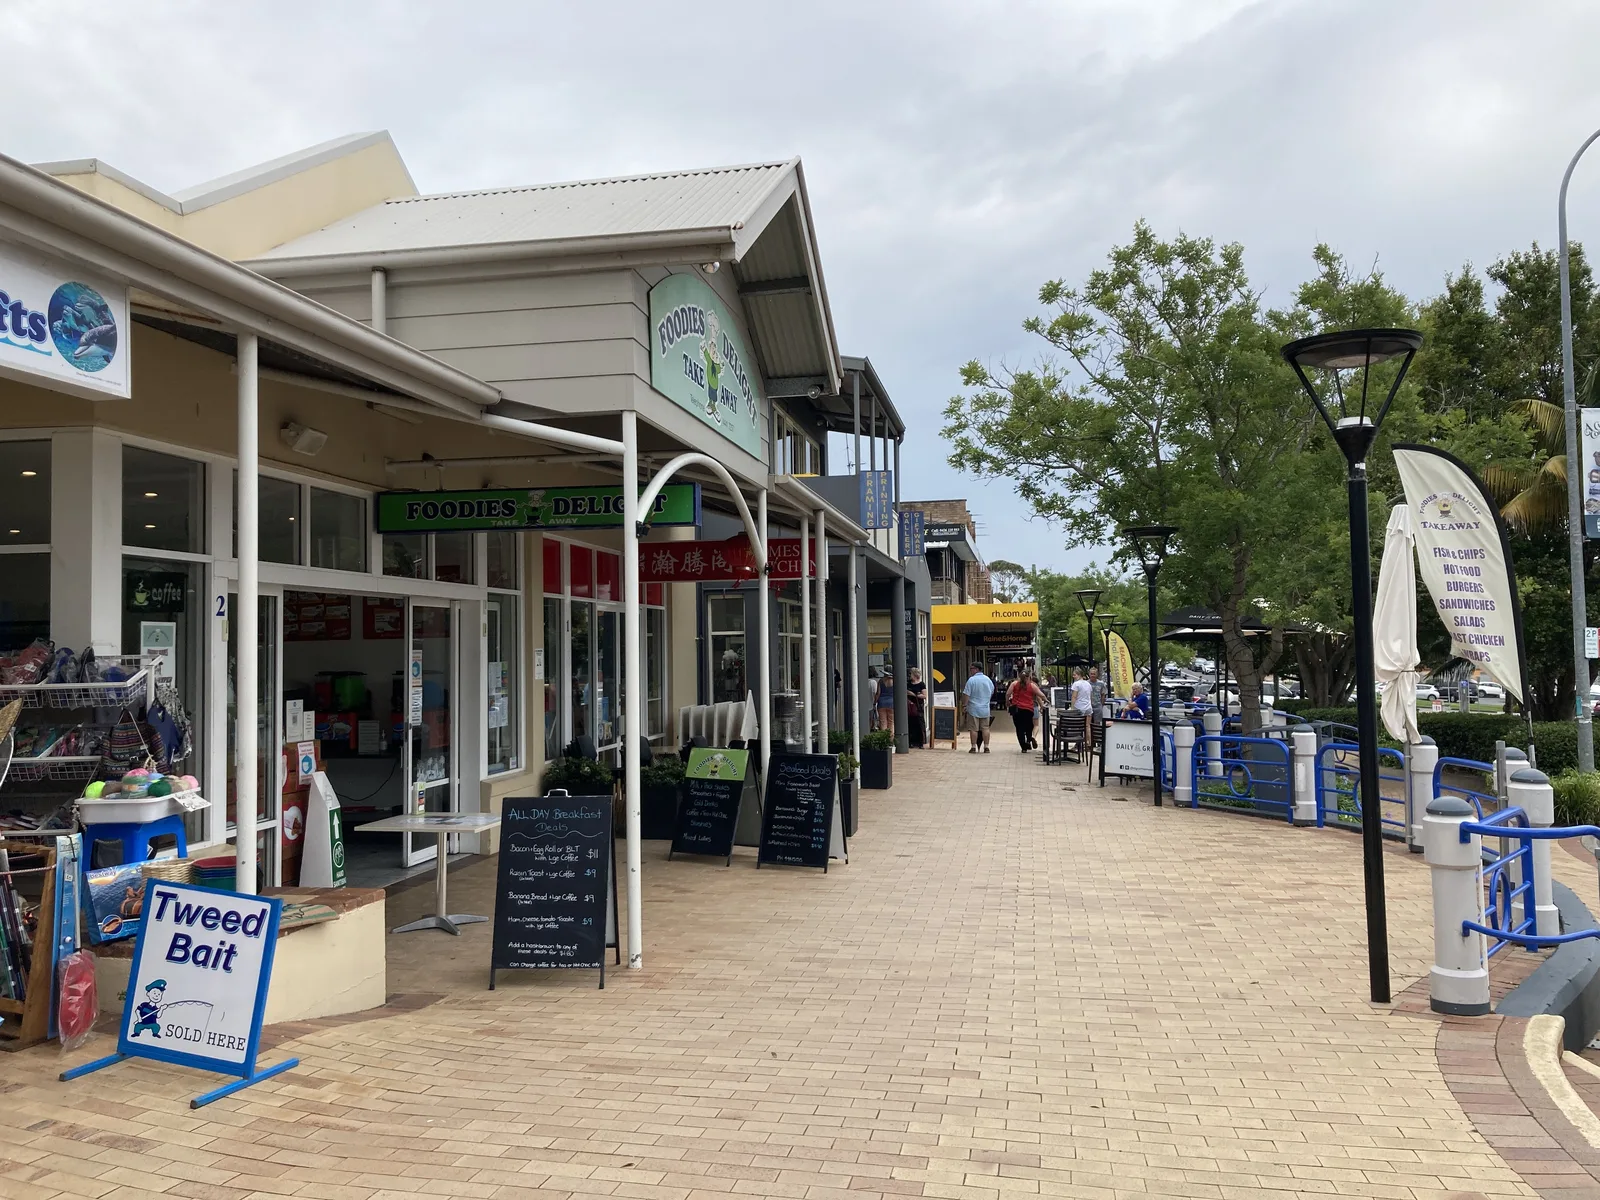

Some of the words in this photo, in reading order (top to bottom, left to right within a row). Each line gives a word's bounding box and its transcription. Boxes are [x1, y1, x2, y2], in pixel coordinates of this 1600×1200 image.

[0, 289, 47, 343] fts
[658, 304, 705, 357] FOODIES
[722, 331, 758, 428] DELIGHT
[682, 352, 705, 389] TAKE
[719, 383, 738, 415] AWAY
[865, 471, 874, 527] FRAMING
[880, 471, 888, 527] PRINTING
[1452, 492, 1482, 515] DELIGHT
[406, 498, 517, 520] FOODIES
[551, 493, 668, 517] DELIGT
[490, 519, 519, 527] TAKE
[549, 517, 579, 525] AWAY
[1420, 521, 1481, 531] TAKEAWAY
[768, 544, 801, 558] MES
[1433, 547, 1451, 559] FISH
[1458, 548, 1486, 560] CHIPS
[1443, 563, 1459, 575] HOT
[1459, 565, 1481, 577] FOOD
[152, 582, 182, 604] coffee
[1446, 581, 1485, 594] BURGERS
[216, 595, 226, 617] 2
[1439, 598, 1496, 612] SANDWICHES
[991, 610, 1033, 618] rh.com.au
[1453, 615, 1486, 628] SALADS
[1110, 637, 1119, 654] Thai
[1453, 632, 1467, 644] AST
[1468, 633, 1505, 647] CHICKEN
[1461, 649, 1491, 663] WRAPS
[779, 761, 810, 774] Seafood
[811, 764, 832, 776] Deals
[508, 808, 530, 821] ALL
[530, 808, 551, 820] DAY
[552, 806, 603, 821] Breakfast
[535, 822, 569, 833] Deals
[510, 843, 531, 853] Bacon
[533, 844, 545, 855] Egg
[545, 844, 557, 853] Roll
[566, 845, 581, 853] BLT
[586, 848, 599, 860] $11
[560, 854, 579, 863] Coffee
[528, 869, 545, 877] Toast
[558, 870, 576, 879] Coffee
[584, 869, 597, 879] $9
[508, 891, 530, 900] Banana
[531, 893, 548, 901] Bread
[561, 893, 578, 902] Coffee
[583, 894, 595, 904] $9
[154, 890, 268, 938] Tweed
[582, 917, 593, 926] $9
[165, 932, 238, 973] Bait
[165, 1024, 202, 1043] SOLD
[206, 1032, 247, 1052] HERE
